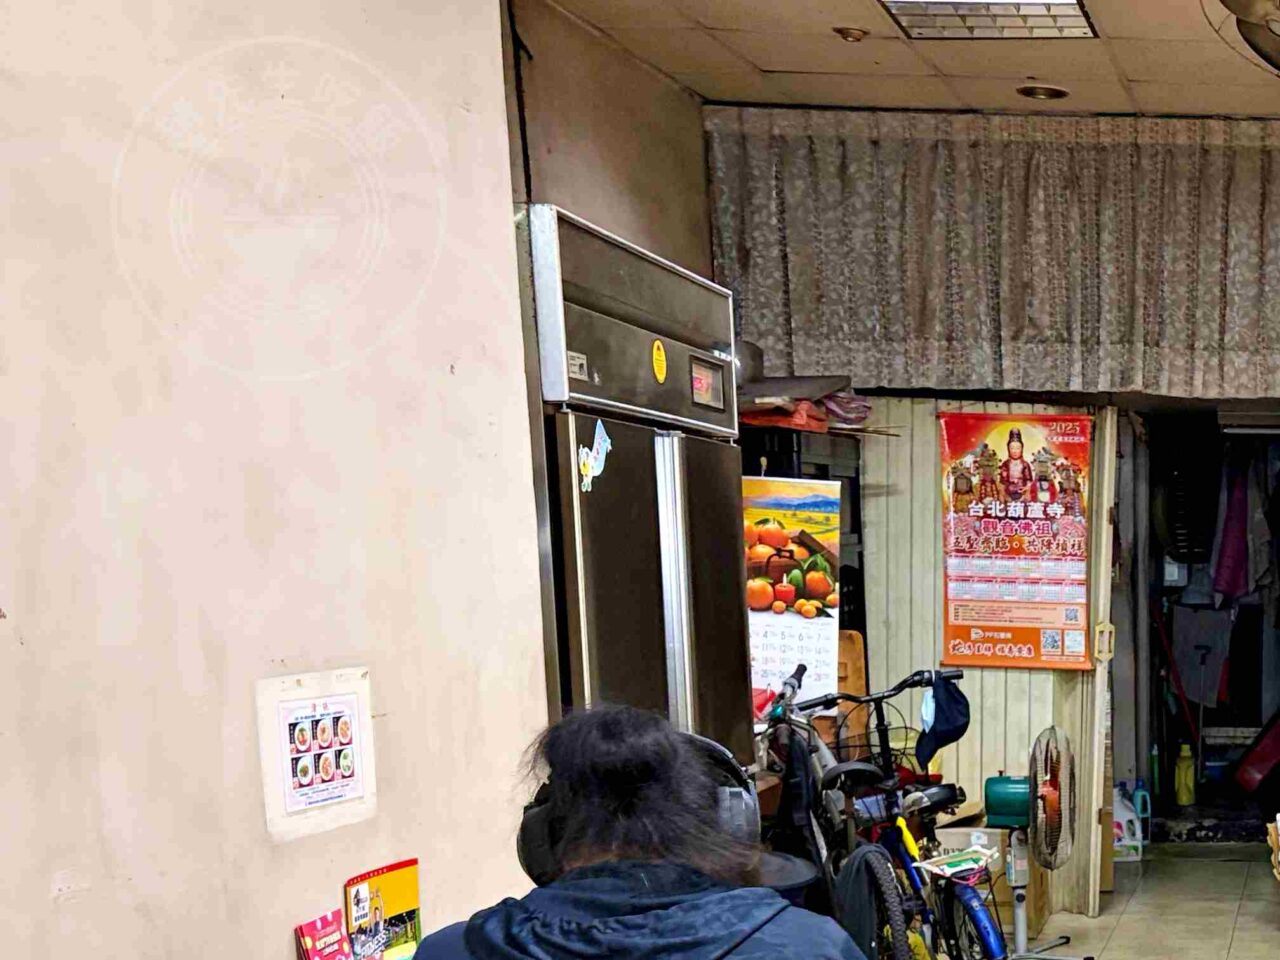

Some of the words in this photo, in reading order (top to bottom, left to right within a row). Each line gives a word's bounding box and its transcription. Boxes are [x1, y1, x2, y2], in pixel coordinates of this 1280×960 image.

[1049, 421, 1081, 434] 2025
[967, 500, 1067, 519] 台北葫蘆寺
[980, 518, 1053, 537] 觀音佛祖
